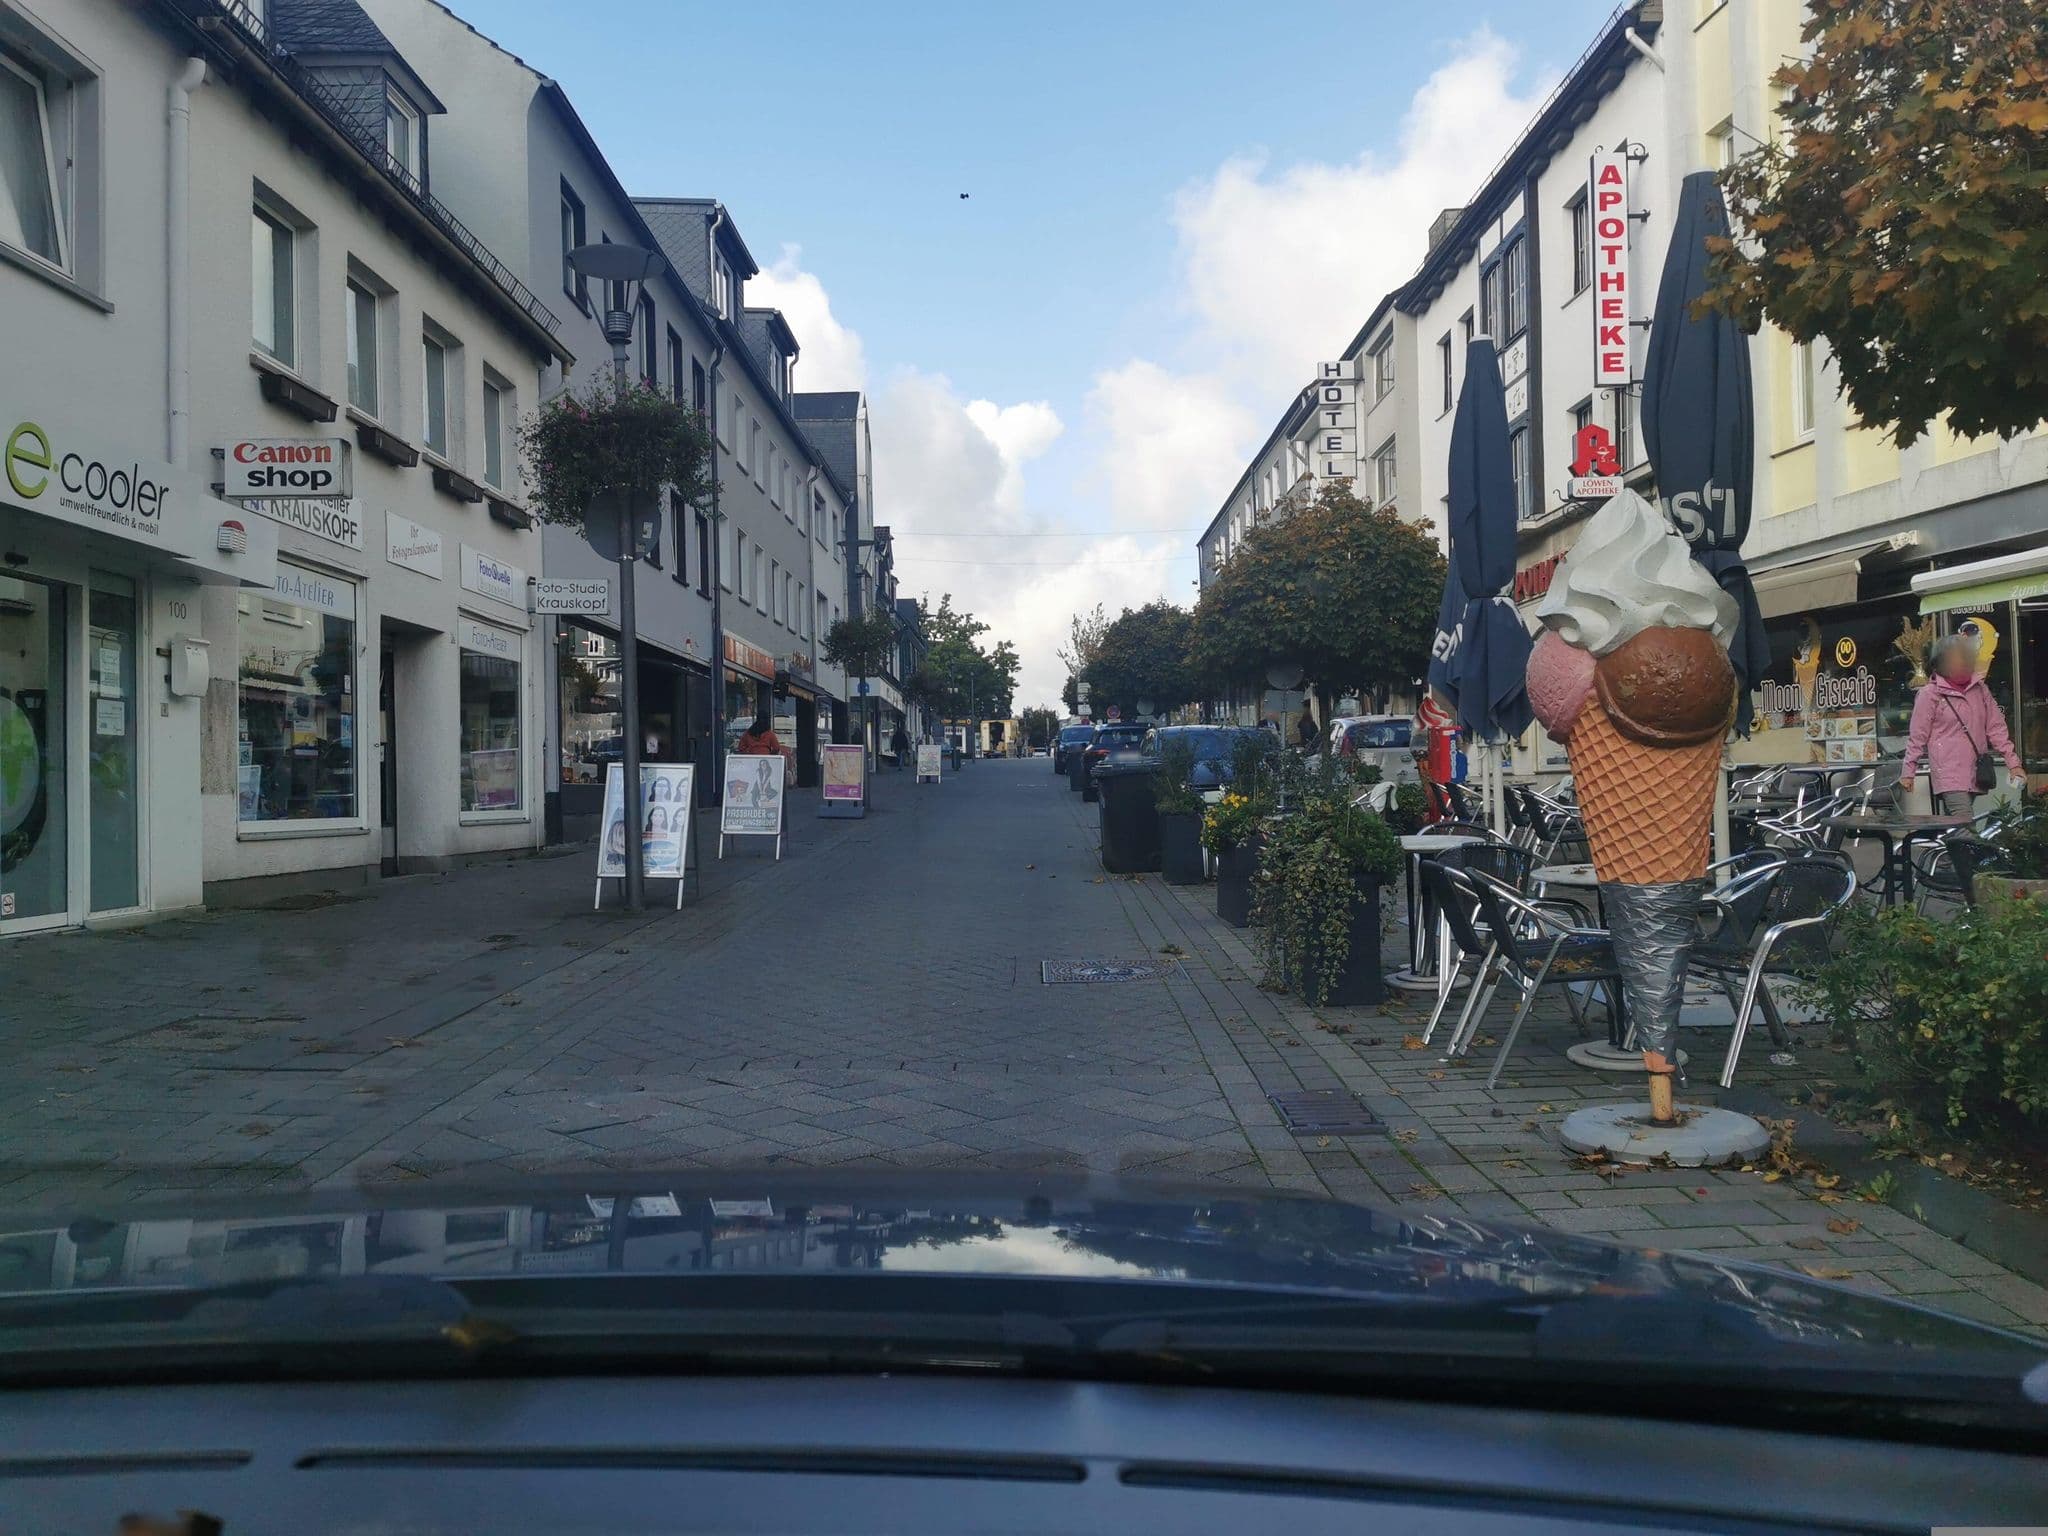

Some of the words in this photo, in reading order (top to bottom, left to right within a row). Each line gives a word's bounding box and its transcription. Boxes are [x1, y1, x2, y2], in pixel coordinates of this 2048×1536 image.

[1597, 163, 1625, 374] APOTHEKE
[1323, 362, 1343, 476] HOTEL
[233, 442, 332, 464] Canon
[247, 469, 332, 491] shop
[1576, 487, 1619, 496] APOTHEKE
[59, 496, 130, 527] umweltfreundlich
[131, 520, 138, 530] &
[138, 523, 159, 536] mobil
[270, 499, 358, 544] KRAUSKOPF
[536, 582, 606, 595] Foto-Studio
[168, 600, 187, 620] 100
[537, 596, 606, 612] Krauskopf
[1761, 679, 1802, 714] Moon
